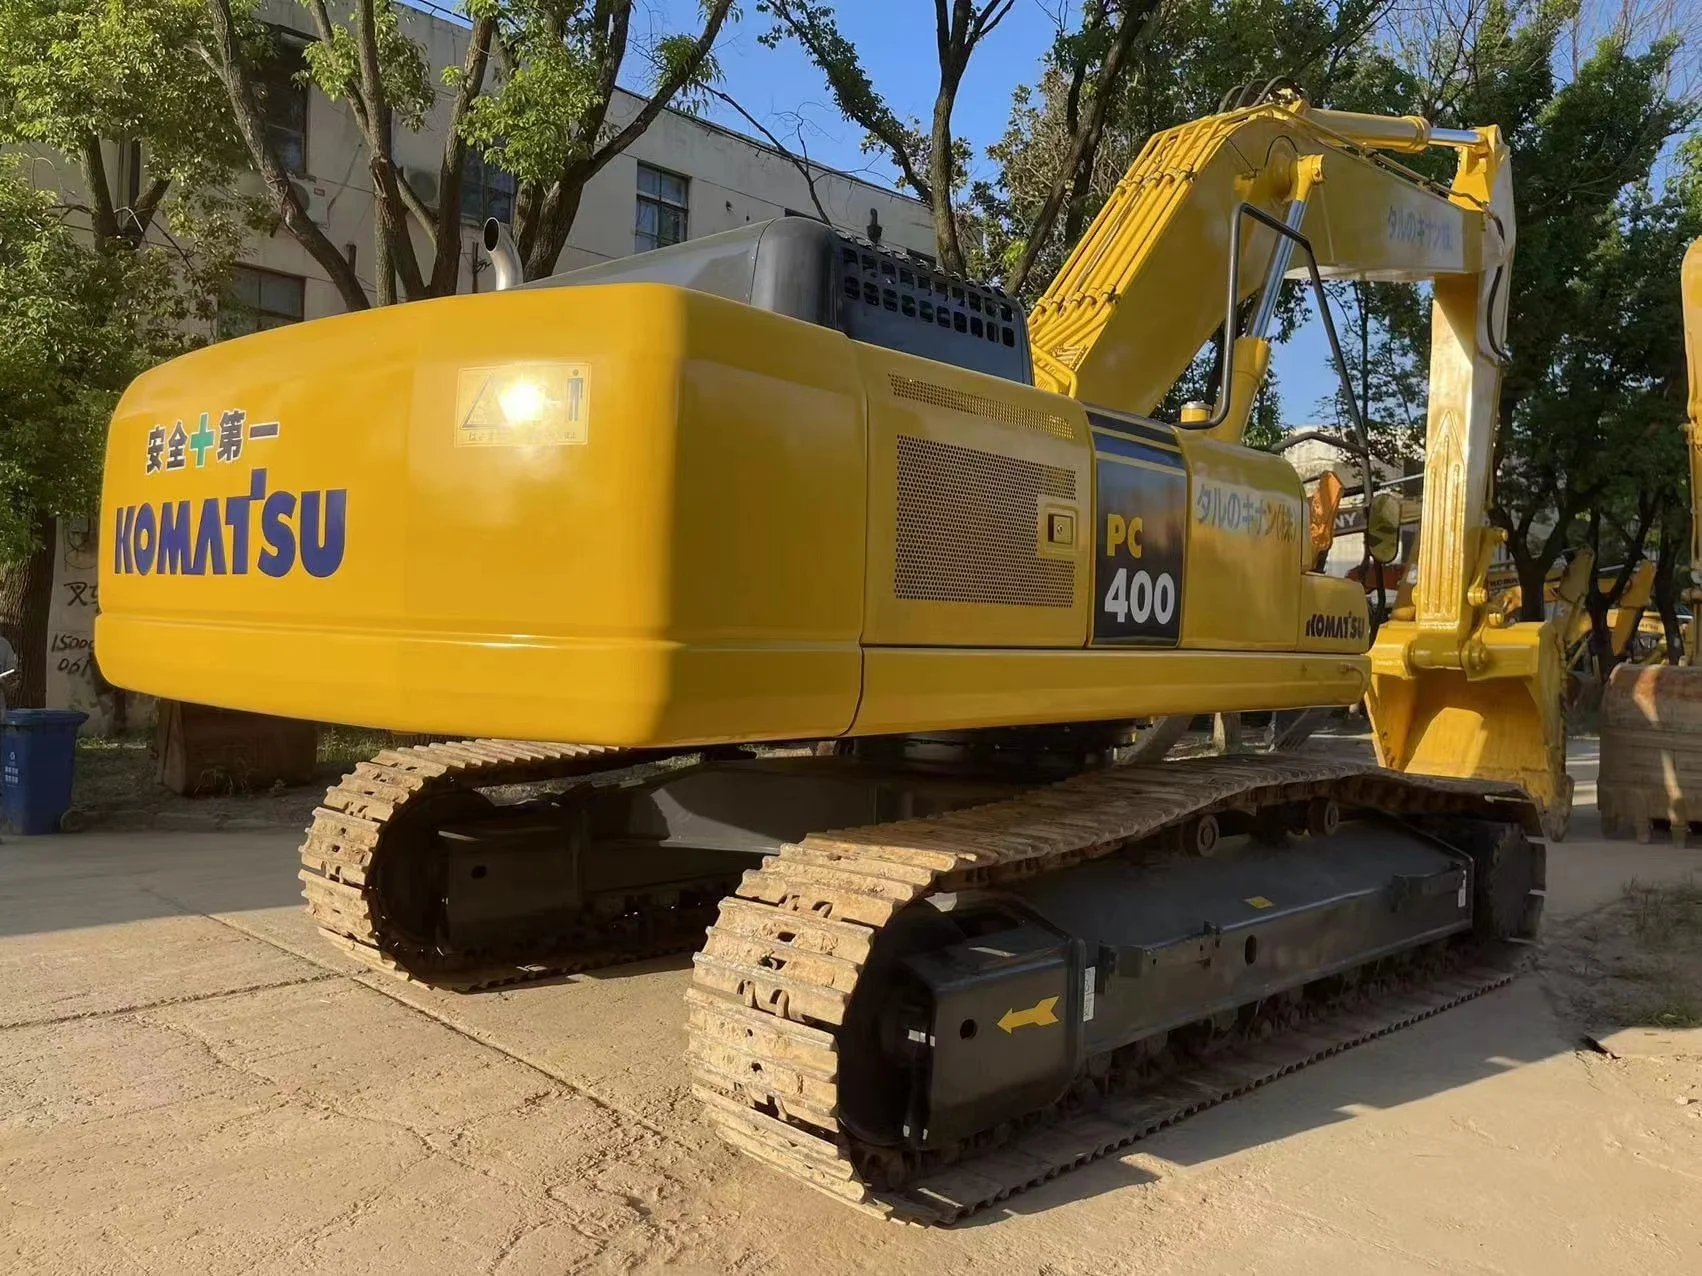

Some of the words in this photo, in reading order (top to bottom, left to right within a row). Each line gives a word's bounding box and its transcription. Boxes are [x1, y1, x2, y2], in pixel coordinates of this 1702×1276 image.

[114, 468, 347, 577] KOMATSU
[1107, 513, 1143, 558] PC
[1104, 568, 1175, 625] 400
[1305, 611, 1364, 638] KOMATSU
